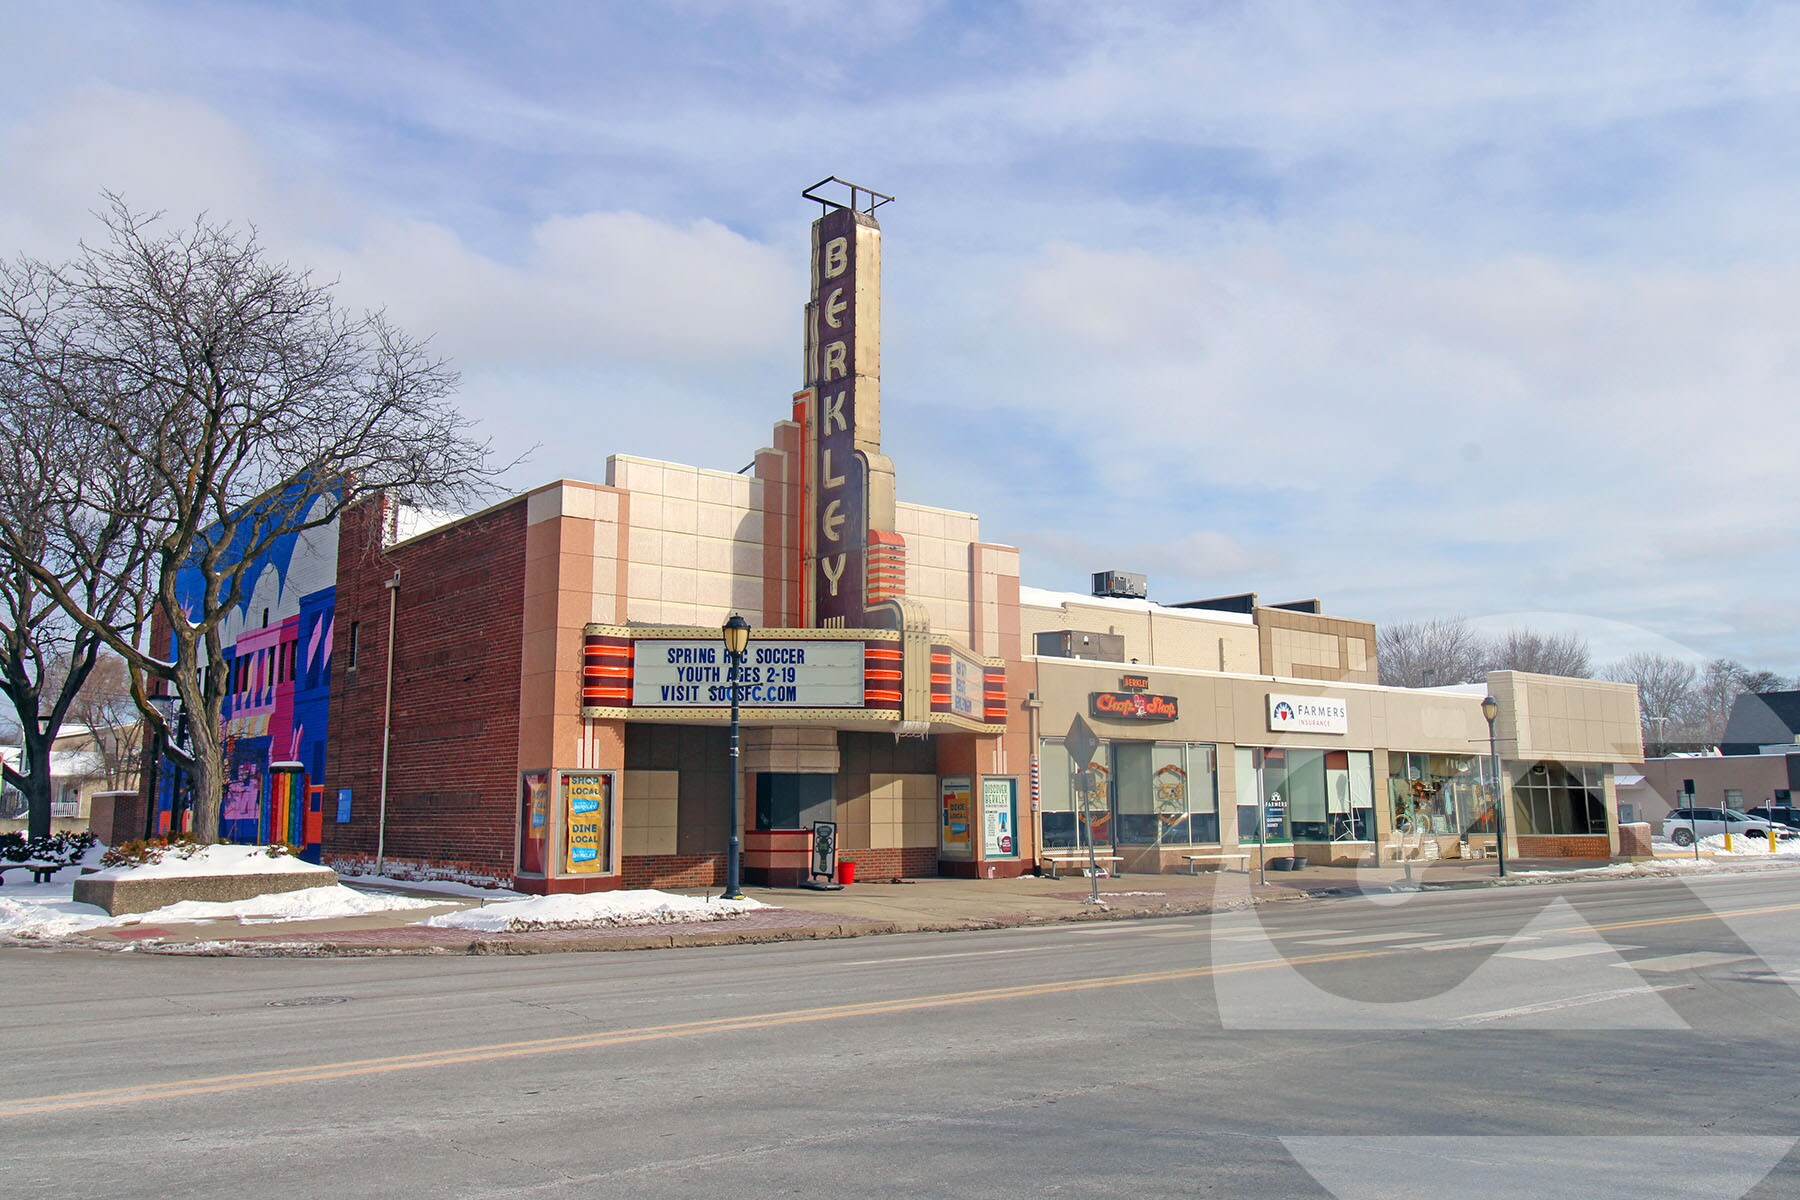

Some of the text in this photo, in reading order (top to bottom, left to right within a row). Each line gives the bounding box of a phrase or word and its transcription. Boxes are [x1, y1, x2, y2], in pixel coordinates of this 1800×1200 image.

[822, 236, 849, 597] BERKLEY
[667, 648, 805, 664] SPRING RC SOCCER
[677, 666, 720, 682] YOUTH
[766, 667, 796, 682] 2-19
[1125, 678, 1148, 688] BERKLEY
[661, 685, 699, 701] VISIT
[1096, 693, 1177, 719] Chop Shop
[1298, 704, 1345, 718] FARMERS
[1299, 719, 1331, 727] INSURANCE
[571, 776, 599, 785] SHOP
[571, 787, 600, 795] LOCAL
[984, 784, 1008, 794] DISCOVER
[985, 794, 1008, 804] BERKLEY
[572, 824, 598, 833] DINE
[570, 835, 598, 843] LOCAL
